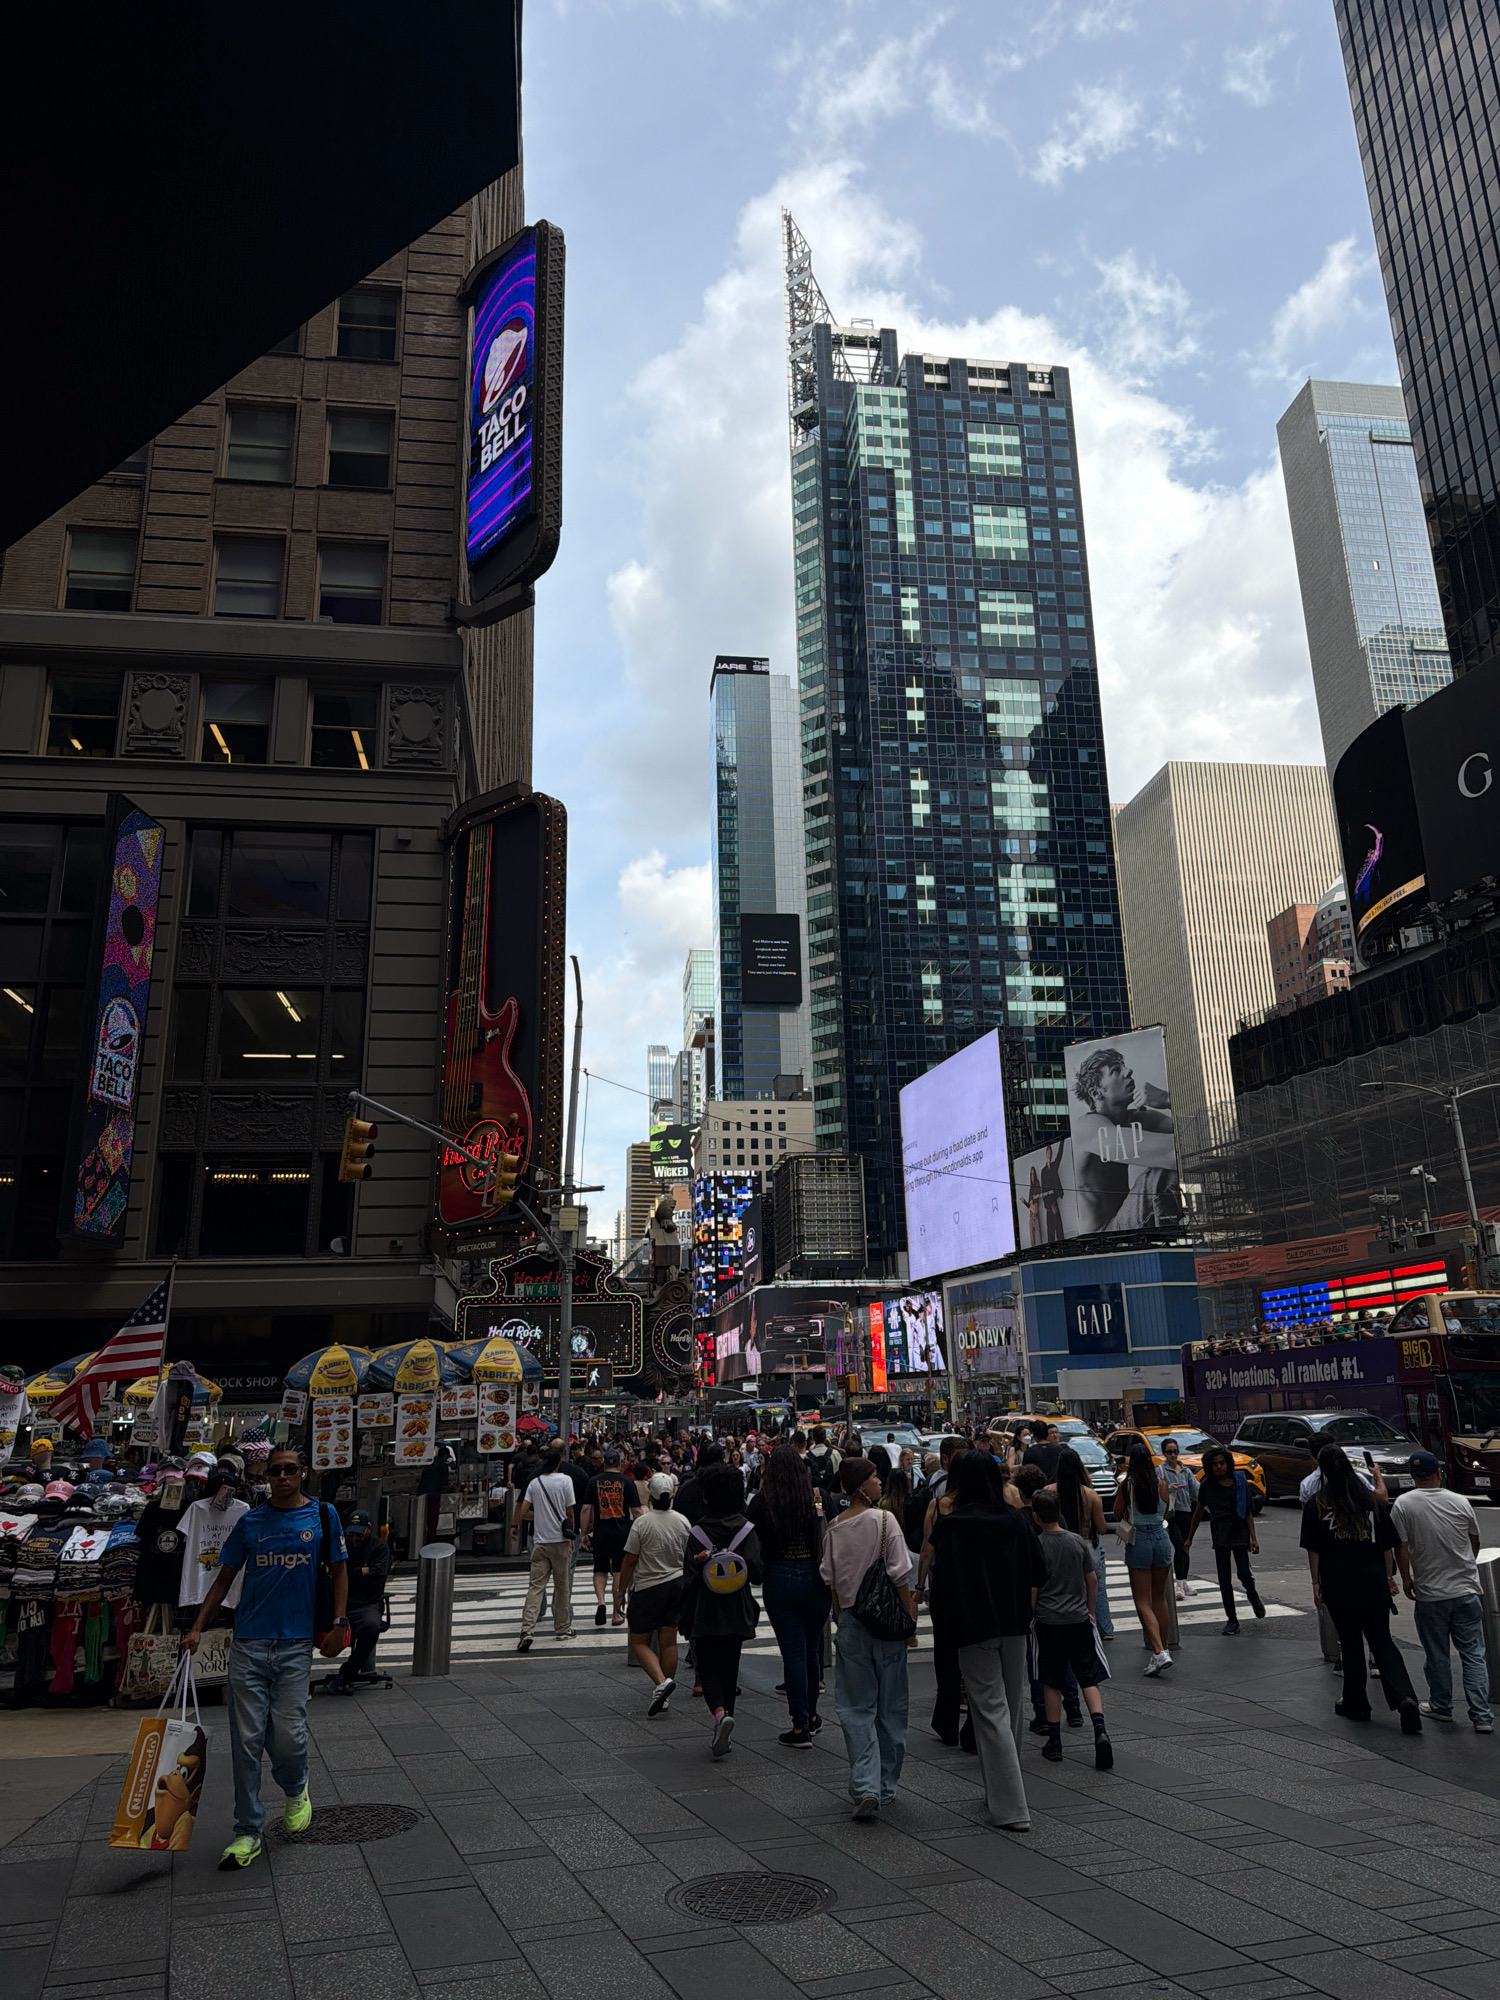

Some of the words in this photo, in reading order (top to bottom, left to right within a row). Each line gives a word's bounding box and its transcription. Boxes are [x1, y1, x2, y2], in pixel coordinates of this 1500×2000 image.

[478, 385, 527, 447] TACO
[480, 413, 527, 473] BELL
[1457, 752, 1493, 799] G
[99, 1053, 132, 1081] TACO
[97, 1073, 128, 1100] BELL
[923, 1155, 932, 1166] out
[932, 1147, 949, 1162] during
[952, 1138, 963, 1153] bad
[964, 1134, 976, 1147] date
[977, 1126, 988, 1142] and
[1097, 1121, 1144, 1163] GAP
[972, 1149, 984, 1164] app
[1321, 1244, 1349, 1253] WINGATE
[513, 1271, 552, 1287] Hard
[554, 1270, 592, 1288] Rck
[525, 1284, 536, 1296] W
[537, 1284, 549, 1296] 43
[1077, 1303, 1112, 1336] GAP
[488, 1325, 514, 1338] Hard
[516, 1325, 543, 1340] Rock
[958, 1330, 977, 1350] OLD
[978, 1327, 1006, 1348] NAVY
[1402, 1340, 1419, 1356] BIG
[317, 1360, 349, 1374] SABRETT
[1403, 1355, 1421, 1369] BUS
[245, 1376, 278, 1387] SHOP
[476, 1370, 521, 1380] SABRETT
[1205, 1369, 1228, 1391] 320+
[1229, 1365, 1280, 1389] locations,
[1281, 1361, 1296, 1385] all
[1297, 1357, 1338, 1384] ranked
[1341, 1356, 1364, 1380] #1.
[311, 1384, 356, 1395] SABRETT
[396, 1380, 440, 1391] SABRETT
[63, 1548, 95, 1559] NY
[202, 1649, 228, 1662] NEW
[131, 1740, 156, 1811] Nintendo
